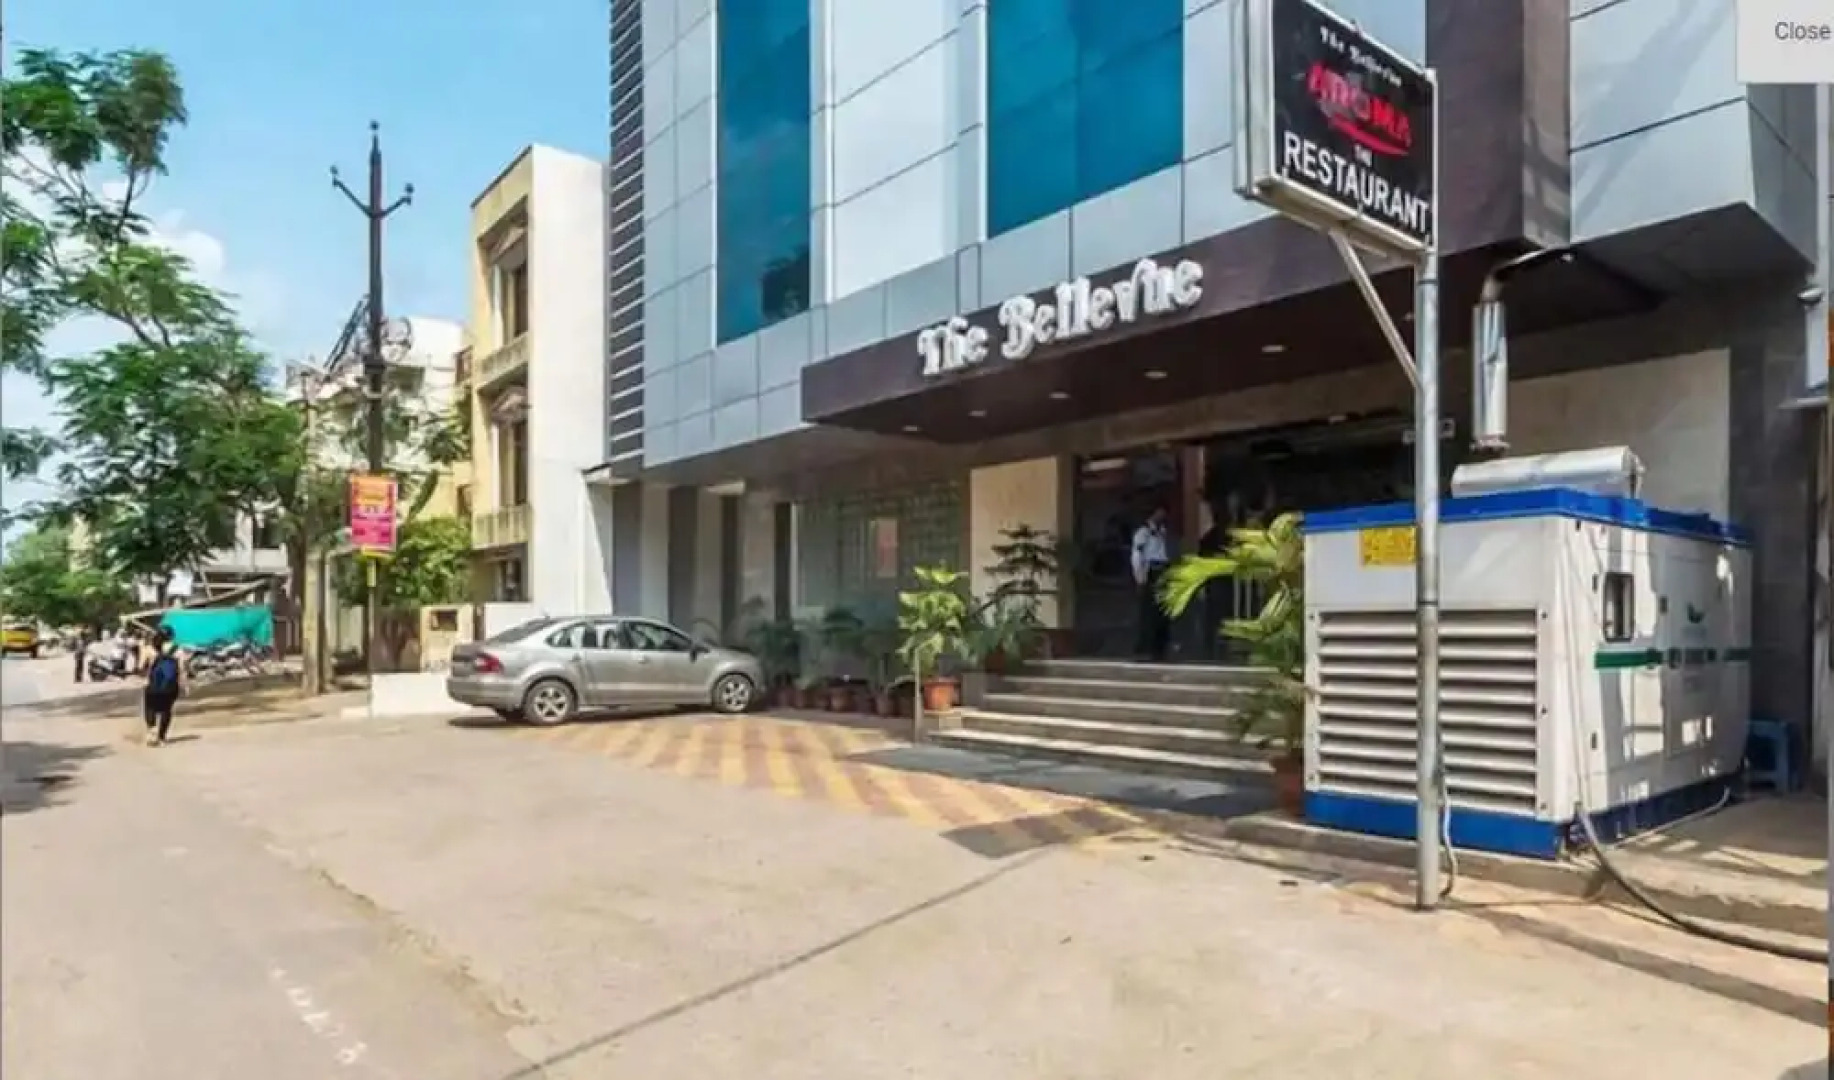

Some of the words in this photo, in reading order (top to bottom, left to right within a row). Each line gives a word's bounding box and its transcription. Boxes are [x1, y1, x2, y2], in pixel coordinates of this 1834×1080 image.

[1283, 129, 1430, 233] RESTAURANT
[916, 315, 989, 376] The
[998, 257, 1204, 360] Bellevue
